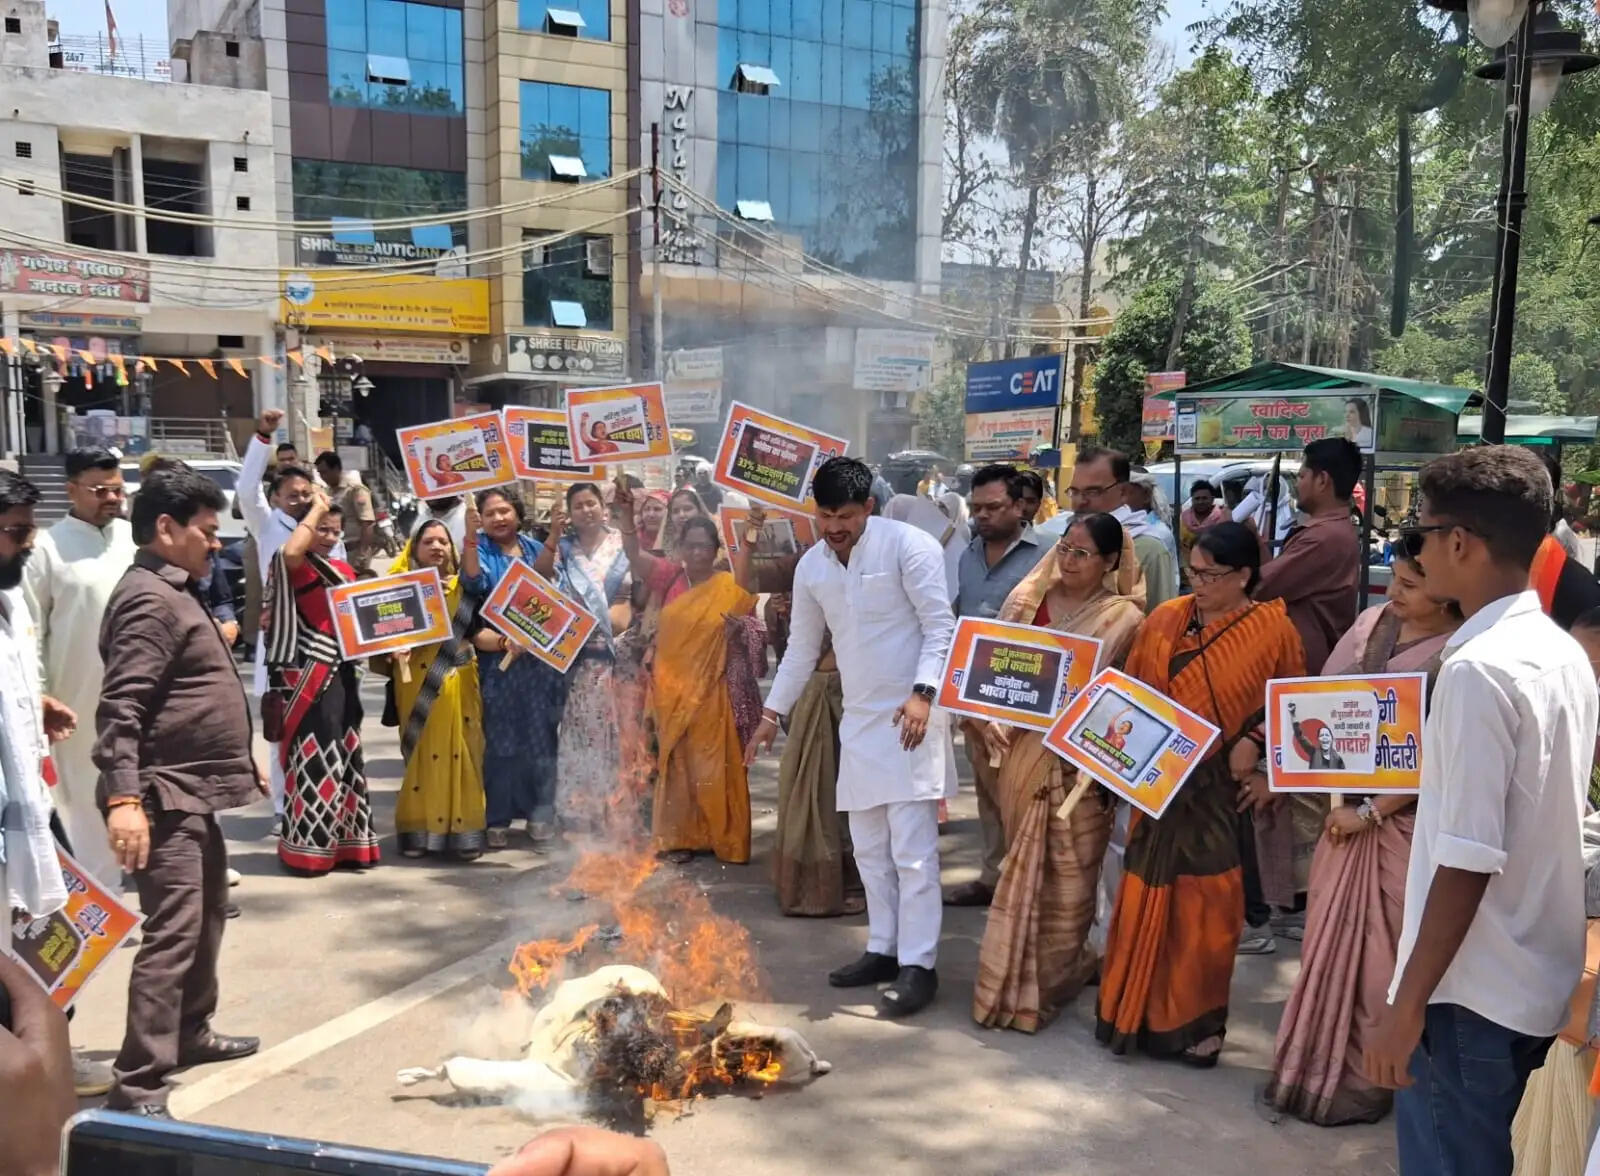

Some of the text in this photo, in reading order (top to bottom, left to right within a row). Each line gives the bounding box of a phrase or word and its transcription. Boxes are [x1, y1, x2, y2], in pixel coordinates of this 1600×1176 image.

[28, 278, 82, 295] जनरल
[529, 337, 622, 354] SHREE BEAUTICIAN
[1010, 369, 1056, 395] CEAT
[1249, 400, 1310, 418] स्वादिष्ट
[1232, 423, 1328, 446] गन्ने का जूस
[989, 656, 1042, 676] झूठी कहानी
[994, 673, 1022, 689] कांग्रेस
[979, 683, 1040, 705] आदत पुरानी
[1375, 732, 1417, 770] गीदारी
